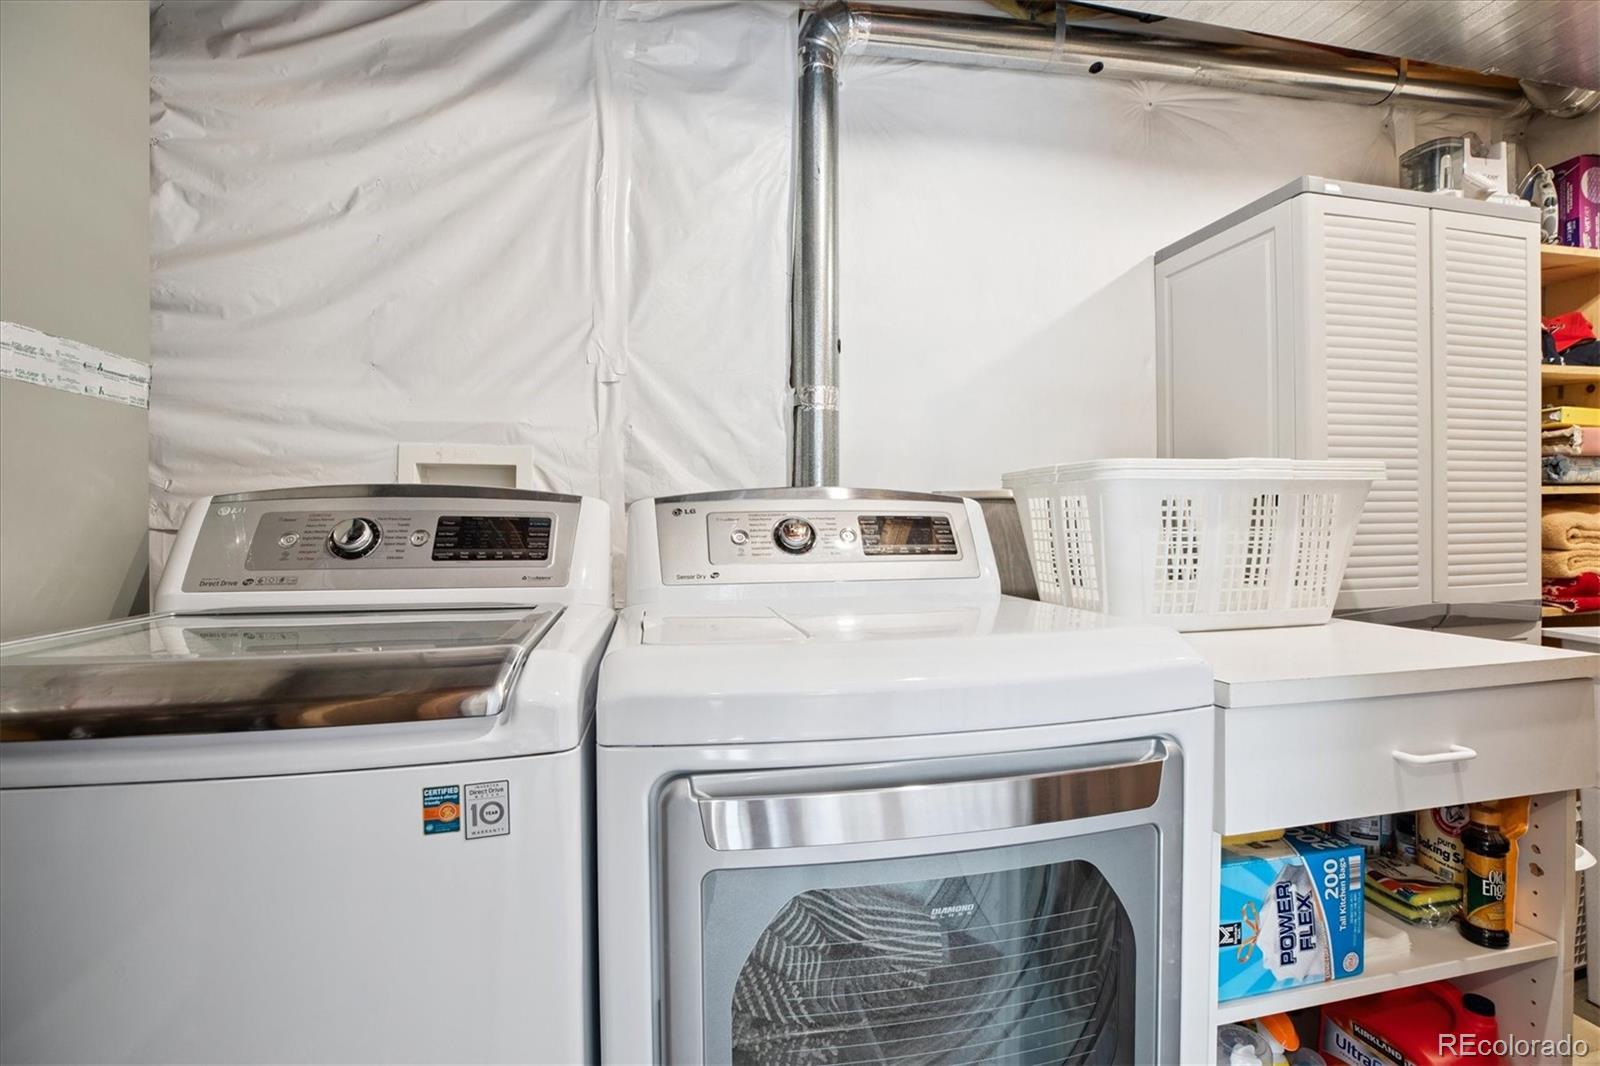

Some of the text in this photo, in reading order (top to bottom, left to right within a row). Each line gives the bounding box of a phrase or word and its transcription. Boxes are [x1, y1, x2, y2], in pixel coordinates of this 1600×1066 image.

[424, 786, 459, 797] CERTIFIED
[470, 801, 505, 827] 10
[471, 827, 504, 836] WARRANTY
[1437, 836, 1457, 850] pure
[1323, 858, 1339, 900] 200
[1339, 857, 1347, 879] Bags
[931, 903, 975, 915] DIAMOND
[1295, 890, 1316, 951] FLEX
[1275, 880, 1296, 966] POWER
[1353, 1023, 1403, 1060] KIRKLAND
